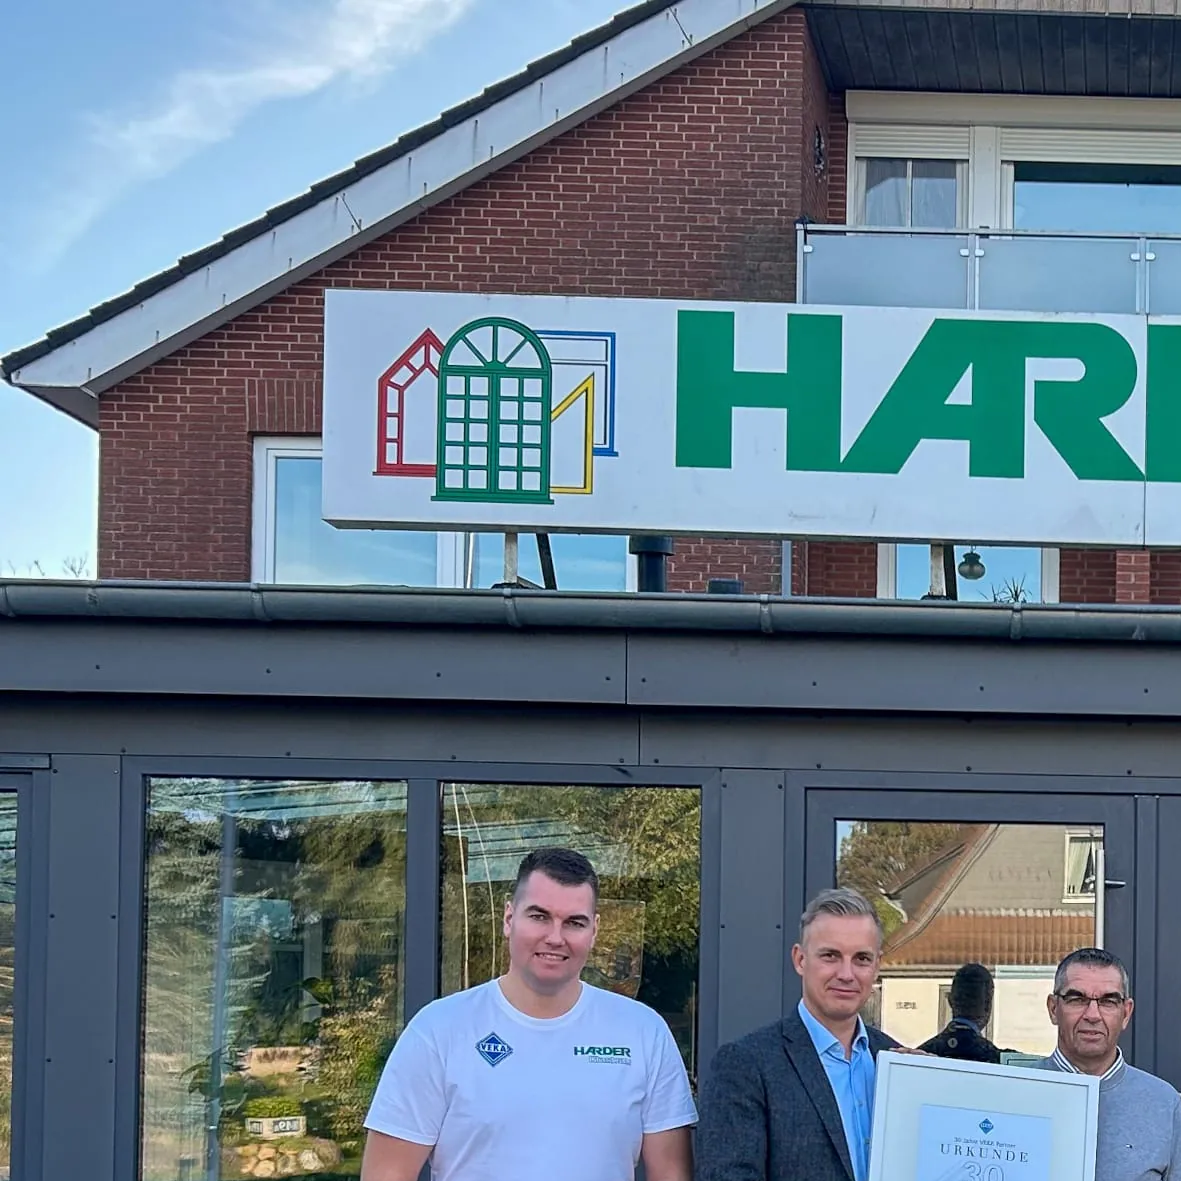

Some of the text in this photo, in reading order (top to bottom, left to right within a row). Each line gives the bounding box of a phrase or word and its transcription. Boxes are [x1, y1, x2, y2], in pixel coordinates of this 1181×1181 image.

[480, 1043, 507, 1052] VEKA
[574, 1046, 631, 1057] HARDER
[940, 1143, 1029, 1163] URKUNDE
